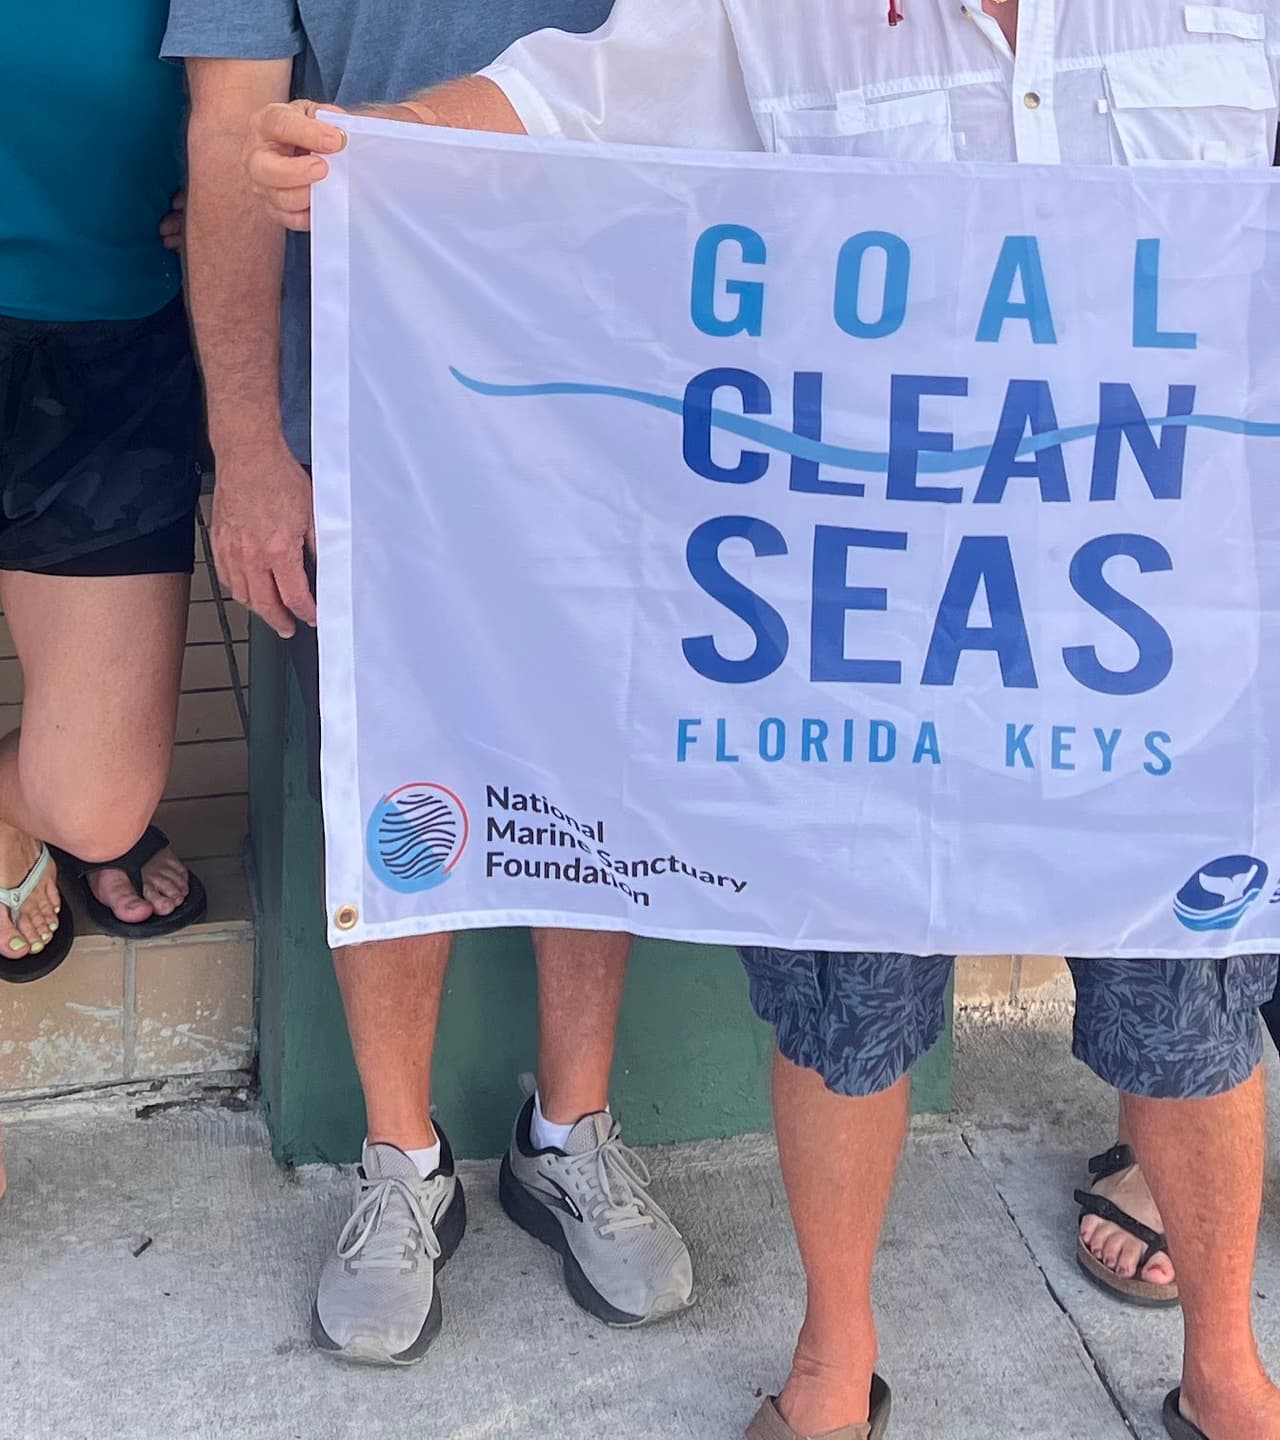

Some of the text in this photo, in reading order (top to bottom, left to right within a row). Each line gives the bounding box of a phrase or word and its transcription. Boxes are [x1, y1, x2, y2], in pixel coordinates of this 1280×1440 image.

[690, 224, 1197, 349] GOAL
[682, 367, 1197, 504] CLEAN
[681, 515, 1174, 695] SEAS
[676, 716, 1173, 776] FLORIDA KEYS
[485, 784, 604, 843] National
[485, 816, 748, 894] Marine Sanctuary
[485, 851, 651, 907] Foundation
